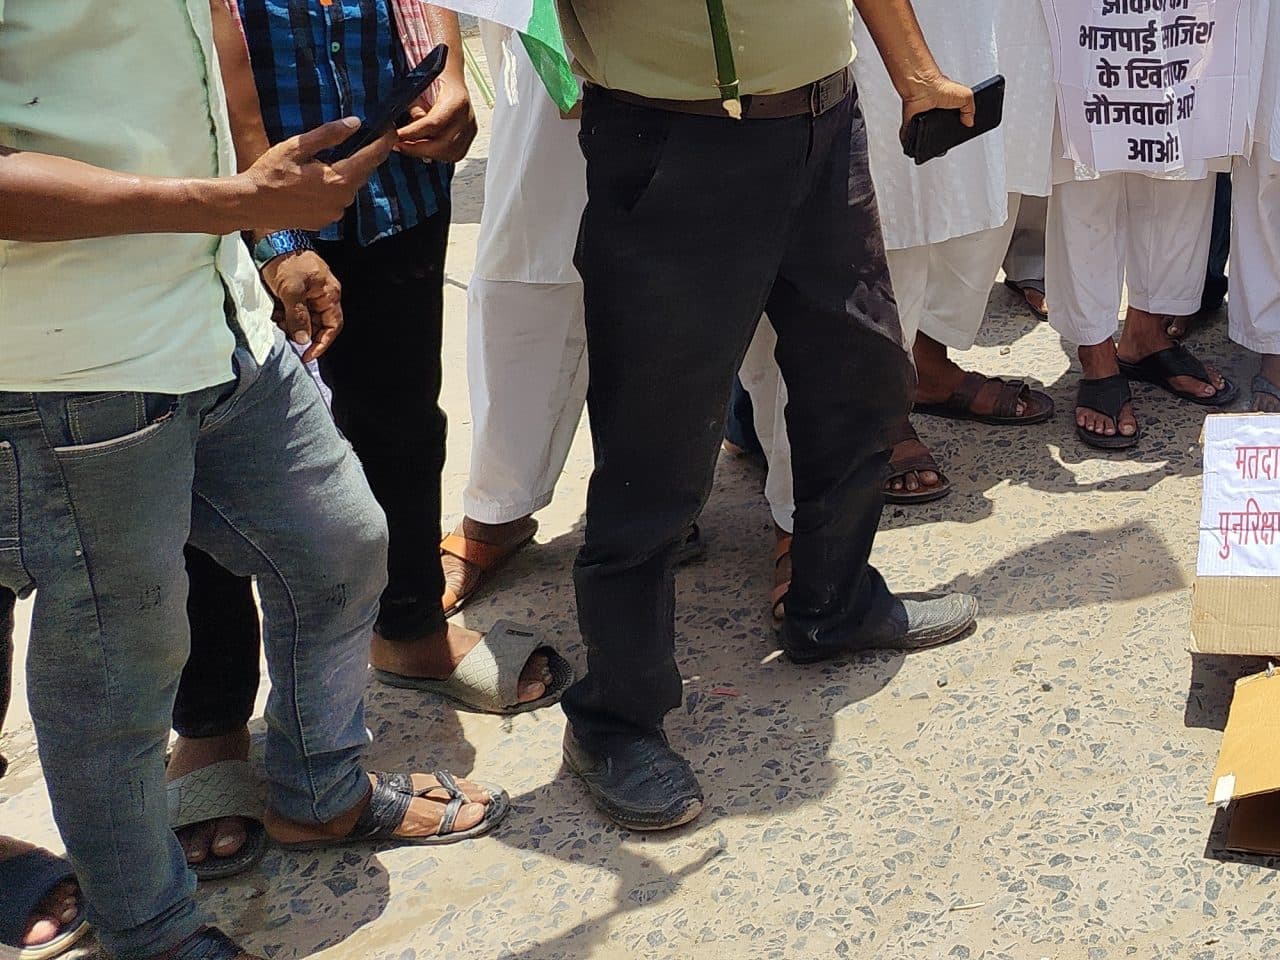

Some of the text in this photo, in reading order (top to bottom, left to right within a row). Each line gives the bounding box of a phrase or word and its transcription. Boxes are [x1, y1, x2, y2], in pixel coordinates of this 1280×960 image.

[1079, 15, 1215, 54] भाजपाई साजिश
[1096, 57, 1190, 89] के खिलाफ
[1083, 94, 1174, 126] नौजवानों
[1127, 132, 1179, 164] आओ!
